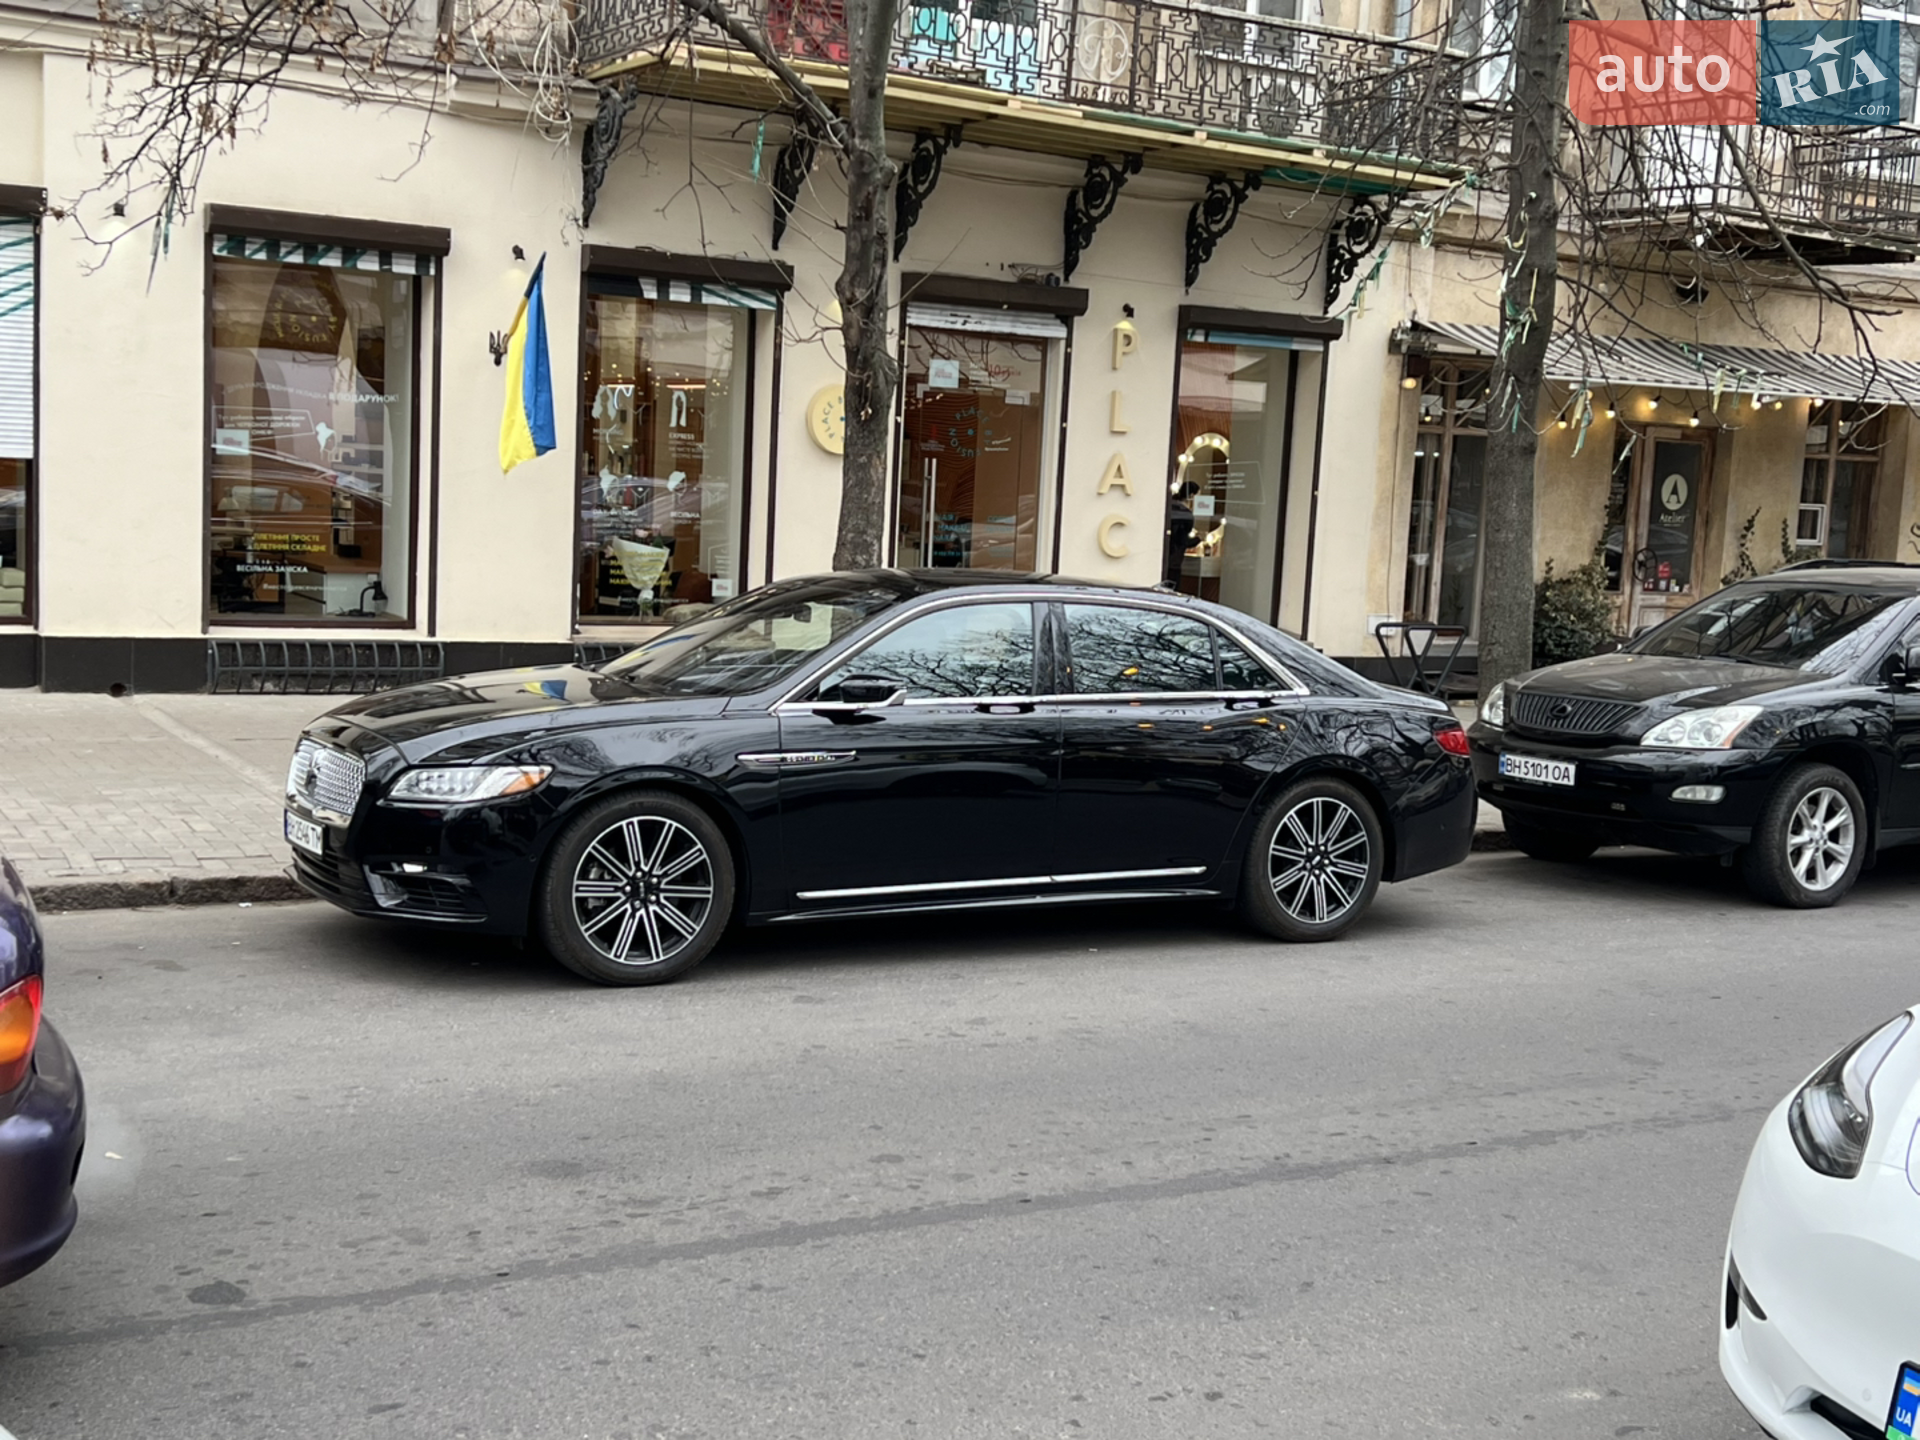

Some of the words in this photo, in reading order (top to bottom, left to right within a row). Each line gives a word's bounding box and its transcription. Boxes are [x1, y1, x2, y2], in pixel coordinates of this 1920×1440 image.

[1096, 327, 1136, 562] PLAC
[1505, 757, 1521, 775] BH
[1522, 760, 1549, 779] 5101
[1551, 765, 1571, 783] OA
[1895, 1406, 1912, 1428] UA
